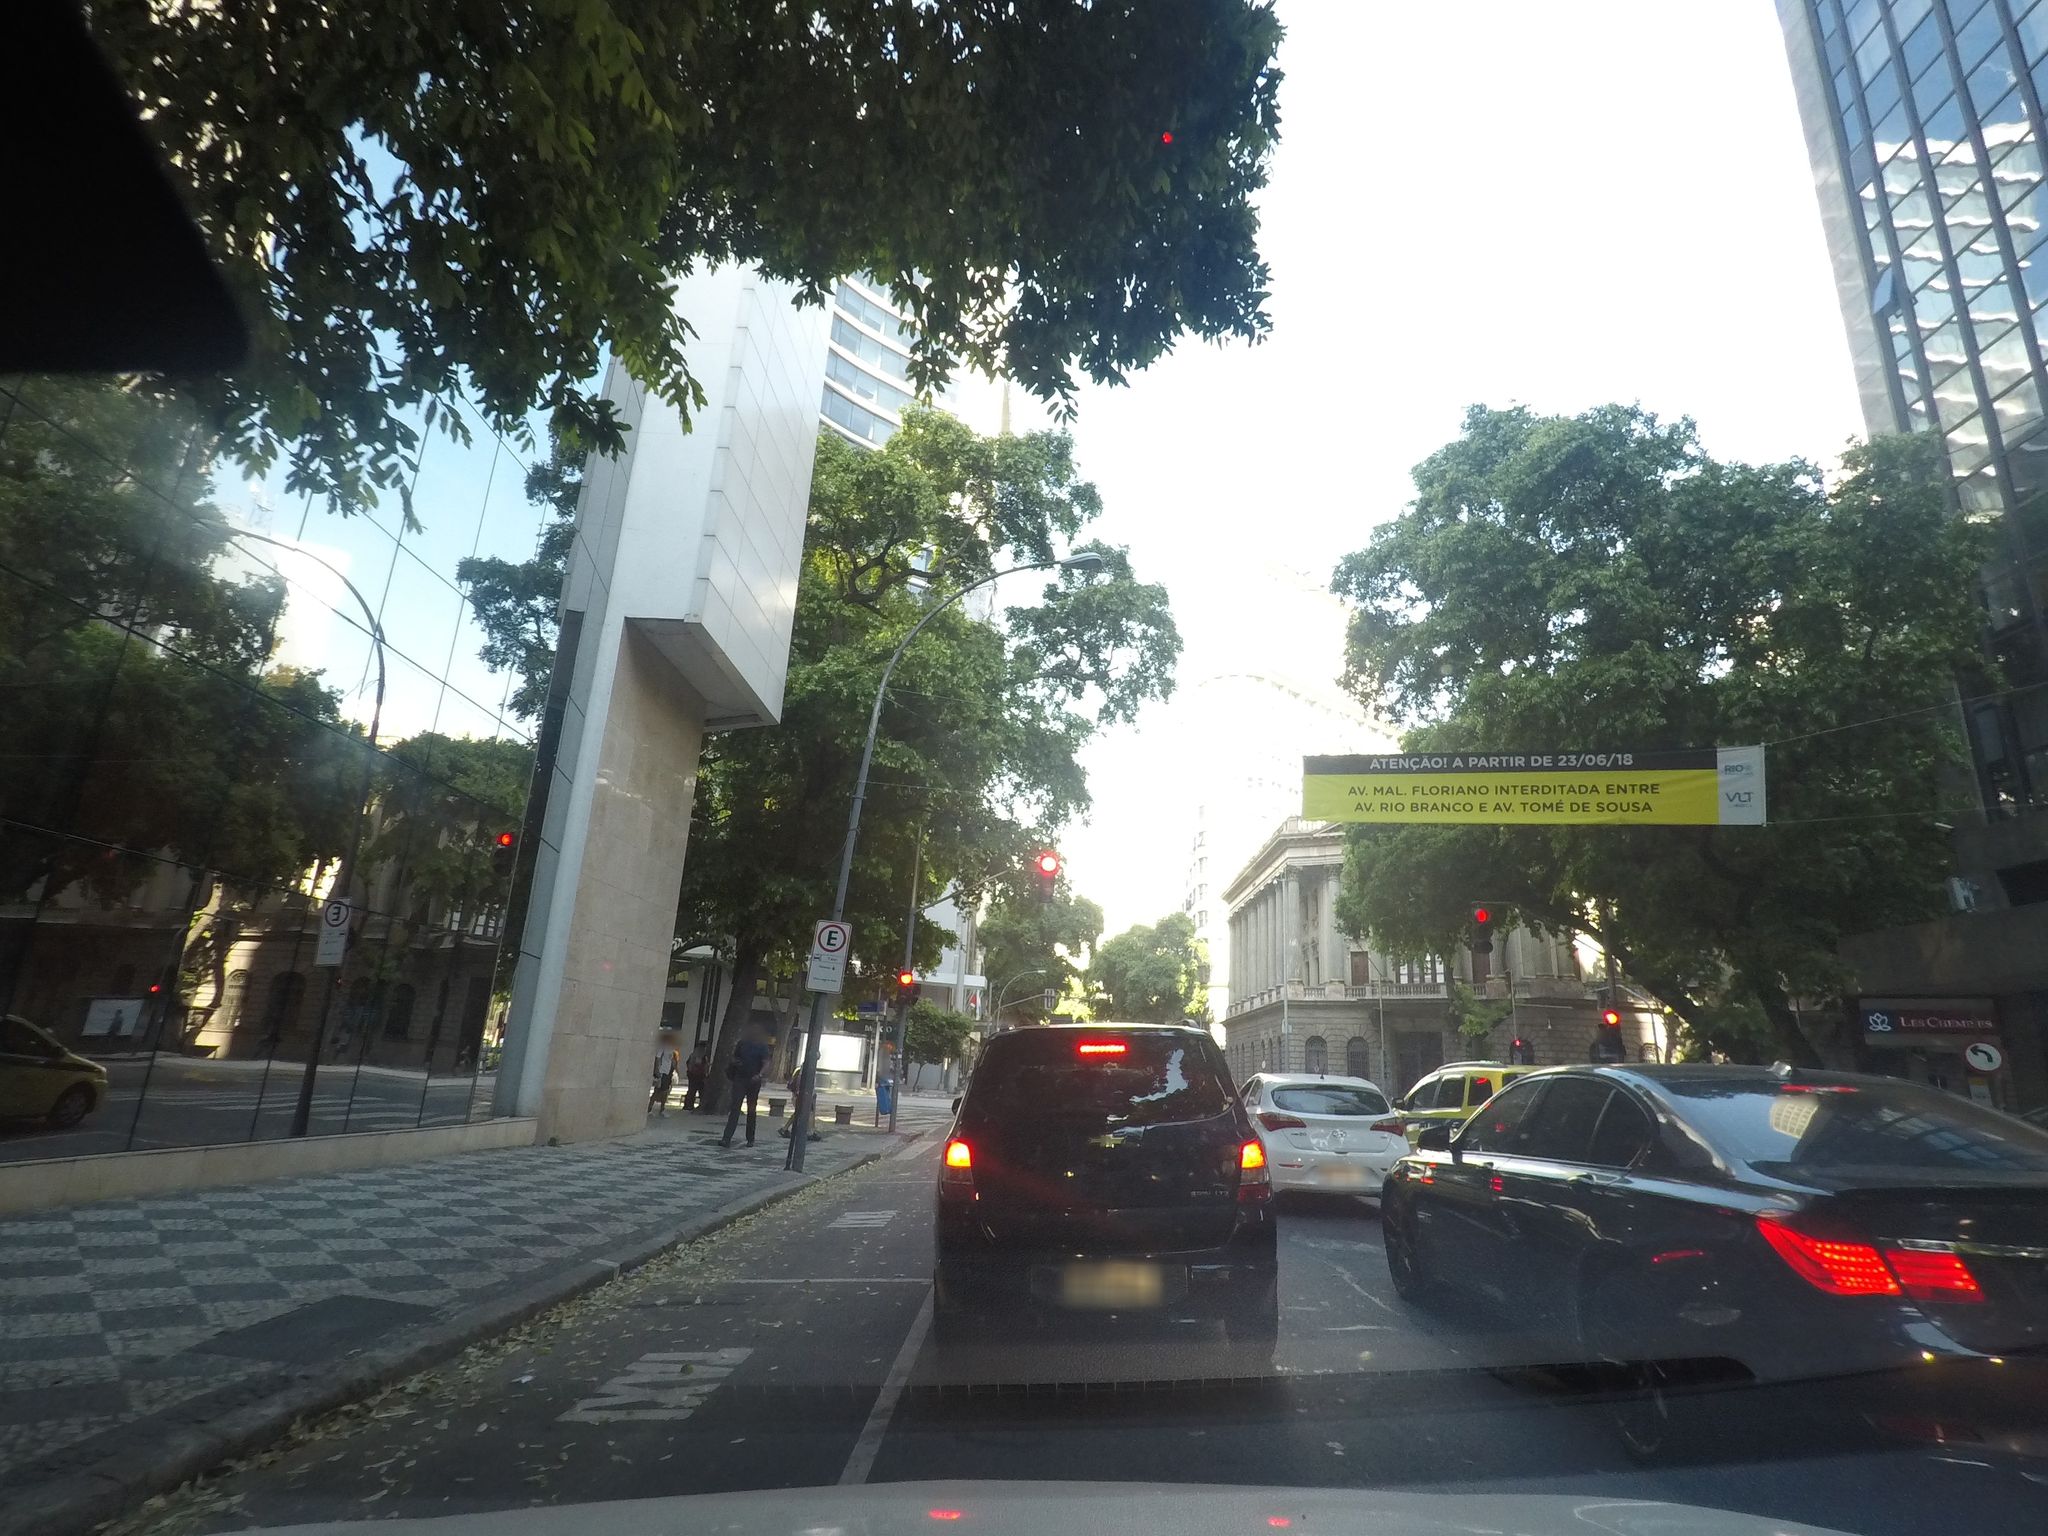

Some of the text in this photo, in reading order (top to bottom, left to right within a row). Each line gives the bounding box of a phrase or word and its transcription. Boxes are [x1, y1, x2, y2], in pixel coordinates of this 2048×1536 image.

[1369, 753, 1634, 770] ATENÇÃO! A PARTIR DE 23/06/18
[1724, 764, 1744, 773] RIO
[1348, 783, 1660, 796] AV. MAL. FLORIANO INTERDITADA ENTRE
[1726, 792, 1753, 803] VLT
[1354, 799, 1653, 813] AV. RIO BRANCO E AV. TOMÉ DE SOUSA
[826, 930, 839, 946] E
